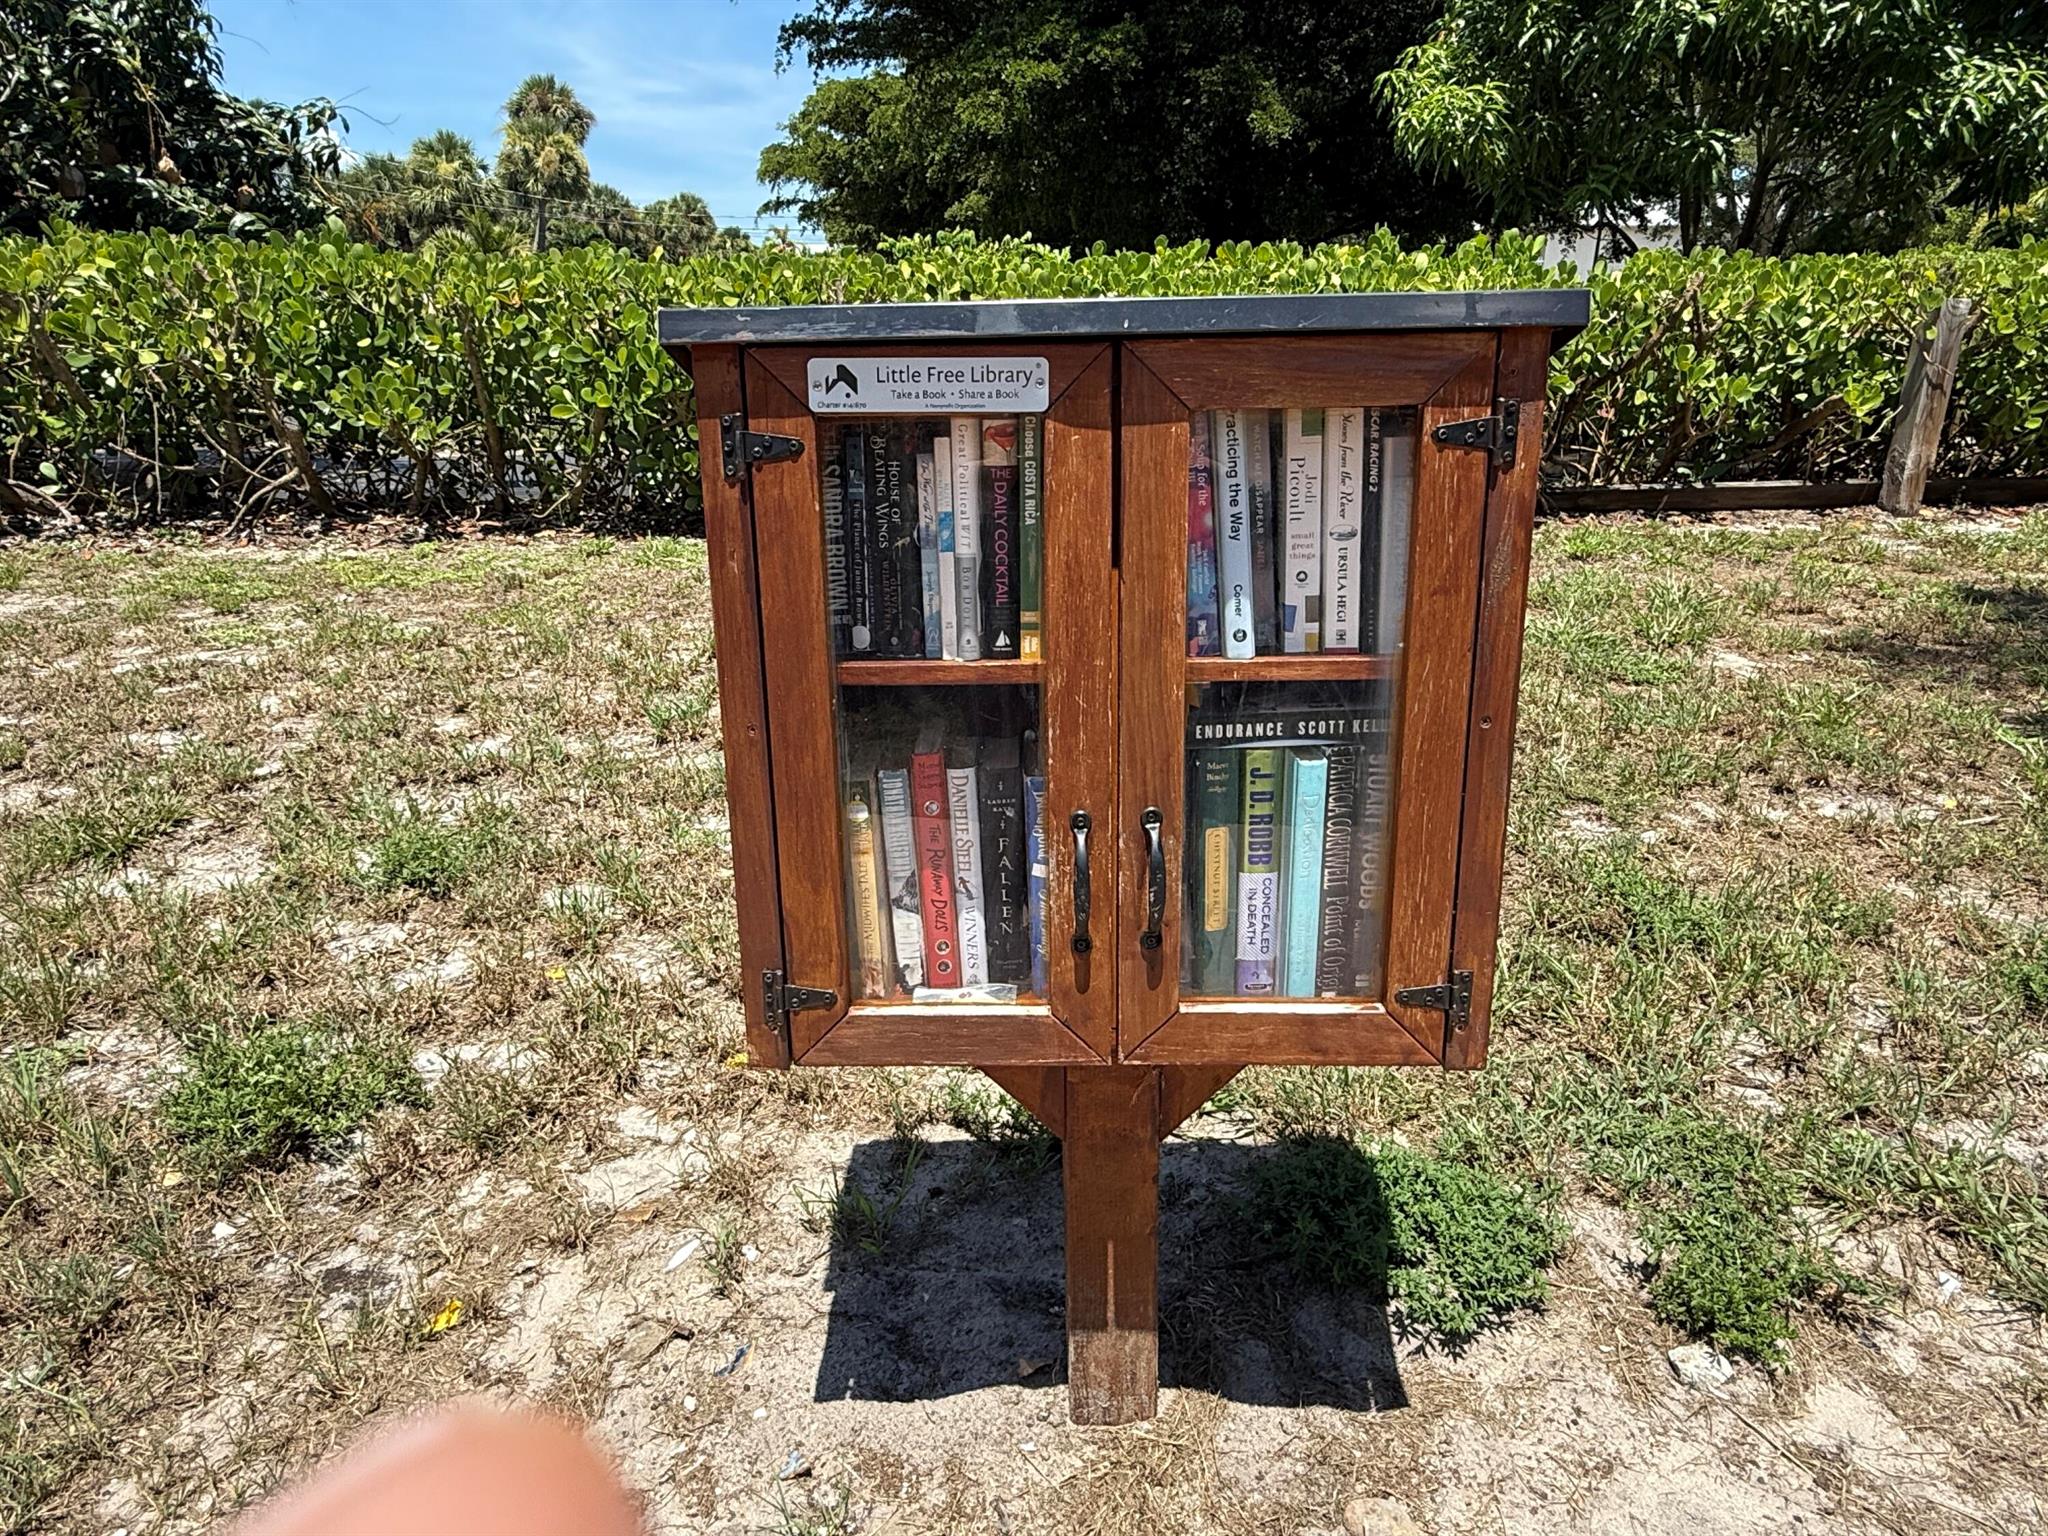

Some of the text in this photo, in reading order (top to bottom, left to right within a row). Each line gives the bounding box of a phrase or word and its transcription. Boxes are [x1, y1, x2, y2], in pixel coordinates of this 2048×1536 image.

[876, 365, 1033, 388] Little Free Library
[890, 389, 912, 399] Take
[923, 389, 947, 399] Book
[958, 389, 986, 399] Share
[995, 389, 1020, 399] Book
[817, 401, 840, 409] Charter
[990, 468, 1012, 479] THE
[1024, 416, 1036, 525] Choose COSTA RICA
[1196, 444, 1208, 469] Soup
[1338, 445, 1355, 469] from
[1368, 408, 1380, 493] SCAR RACING 2
[869, 435, 890, 549] BEATING WINGS
[887, 460, 902, 526] HOUSE OF
[958, 424, 972, 550] Great Political WIT
[1198, 472, 1208, 489] for
[1198, 491, 1208, 506] the
[1229, 483, 1241, 508] the
[1289, 457, 1305, 524] Picoult
[1304, 474, 1317, 504] Jodi
[1340, 471, 1353, 487] the
[1228, 511, 1243, 541] Way
[1255, 480, 1265, 534] DISAPPEAR
[1338, 486, 1354, 520] River
[822, 465, 847, 610] SANDRA BROWN
[994, 482, 1008, 606] DAILY COCKTAIL
[1289, 550, 1316, 560] things
[1290, 531, 1315, 540] small
[1291, 542, 1315, 551] great
[853, 503, 864, 626] The Planet of Junior Brown
[1336, 547, 1348, 623] URSULA HEGI
[1233, 584, 1243, 617] Comer
[1195, 721, 1284, 740] ENDURANCE
[1297, 719, 1345, 735] SCOTT
[950, 774, 975, 874] DANIELLE STEEL
[1248, 767, 1275, 866] J. D. ROBB
[1324, 756, 1355, 890] PATRICIA CORNWELL
[858, 862, 868, 886] TALE
[926, 824, 948, 932] THE RUNAWAY DOLLS
[997, 837, 1014, 936] FALLEN
[1212, 833, 1221, 924] CHESTNUT STREET
[1358, 832, 1385, 910] WOODS
[965, 905, 980, 970] WINNERS
[1247, 888, 1257, 945] IN DEATH
[1260, 877, 1272, 955] CONCEALED
[1325, 896, 1349, 934] Point
[1324, 938, 1346, 952] of
